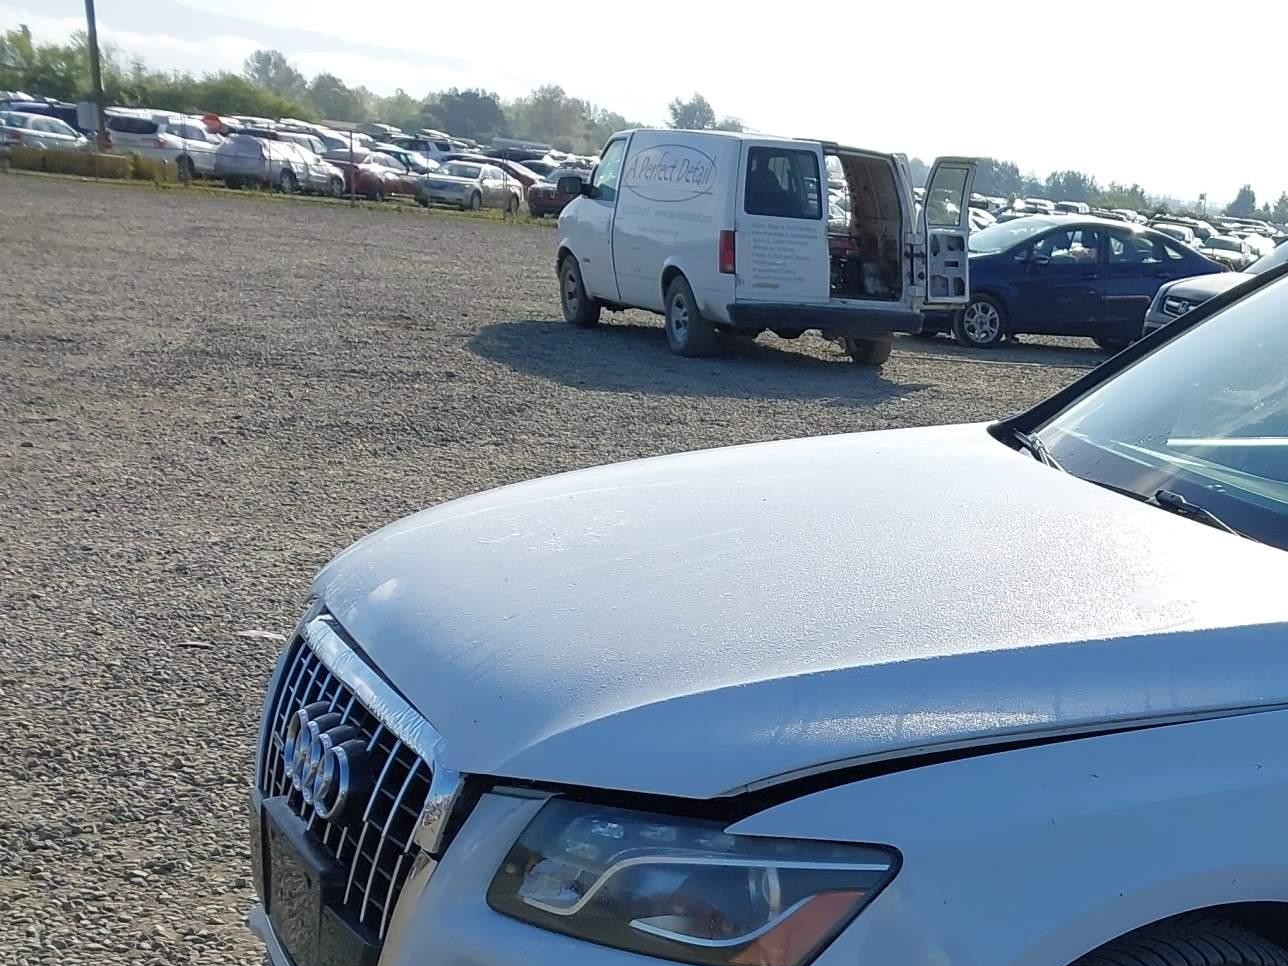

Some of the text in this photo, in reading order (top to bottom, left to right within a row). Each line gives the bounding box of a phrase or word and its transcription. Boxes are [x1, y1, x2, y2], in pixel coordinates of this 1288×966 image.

[626, 151, 717, 185] A Perfect Detail
